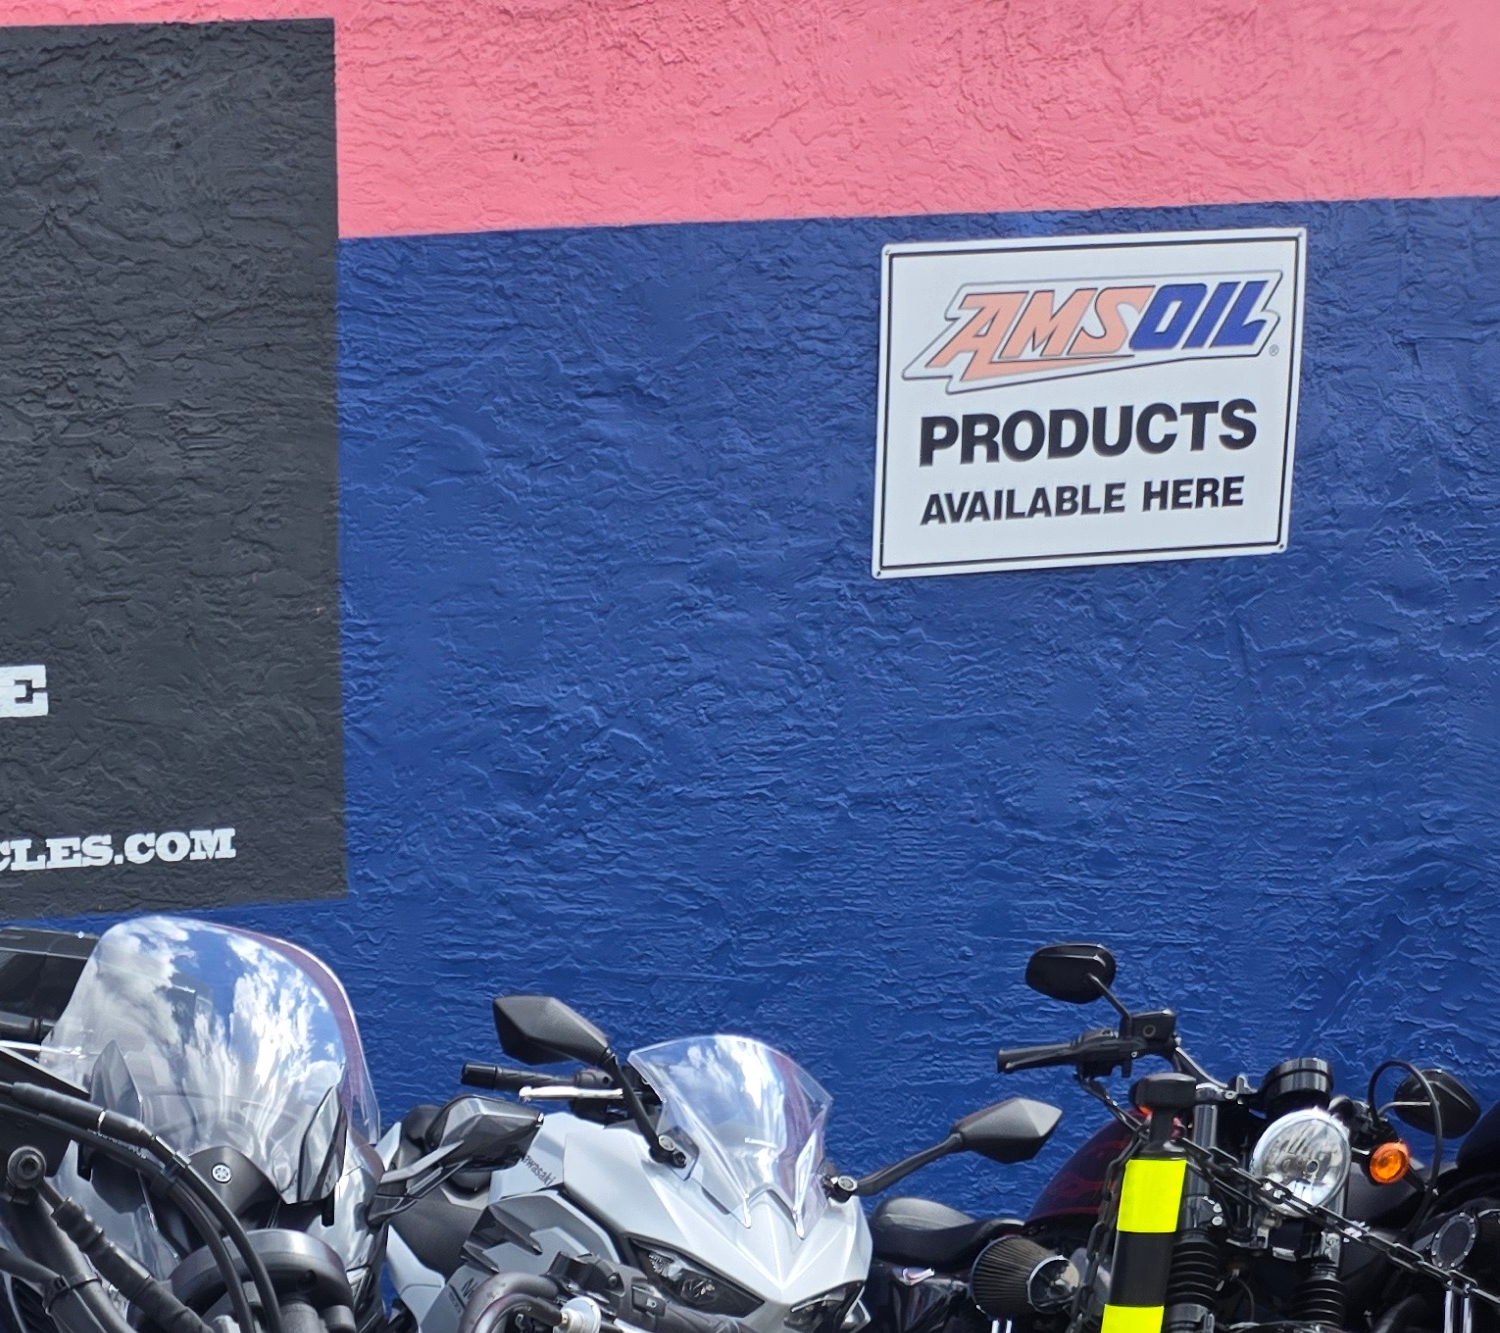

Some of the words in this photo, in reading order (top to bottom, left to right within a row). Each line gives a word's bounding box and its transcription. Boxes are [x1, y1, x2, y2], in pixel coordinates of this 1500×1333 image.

[924, 280, 1269, 383] AMSOIL
[919, 397, 1259, 467] PRODUCTS
[920, 481, 1127, 525] AVAILABLE
[1141, 475, 1245, 512] HERE
[521, 1154, 556, 1187] awasaki
